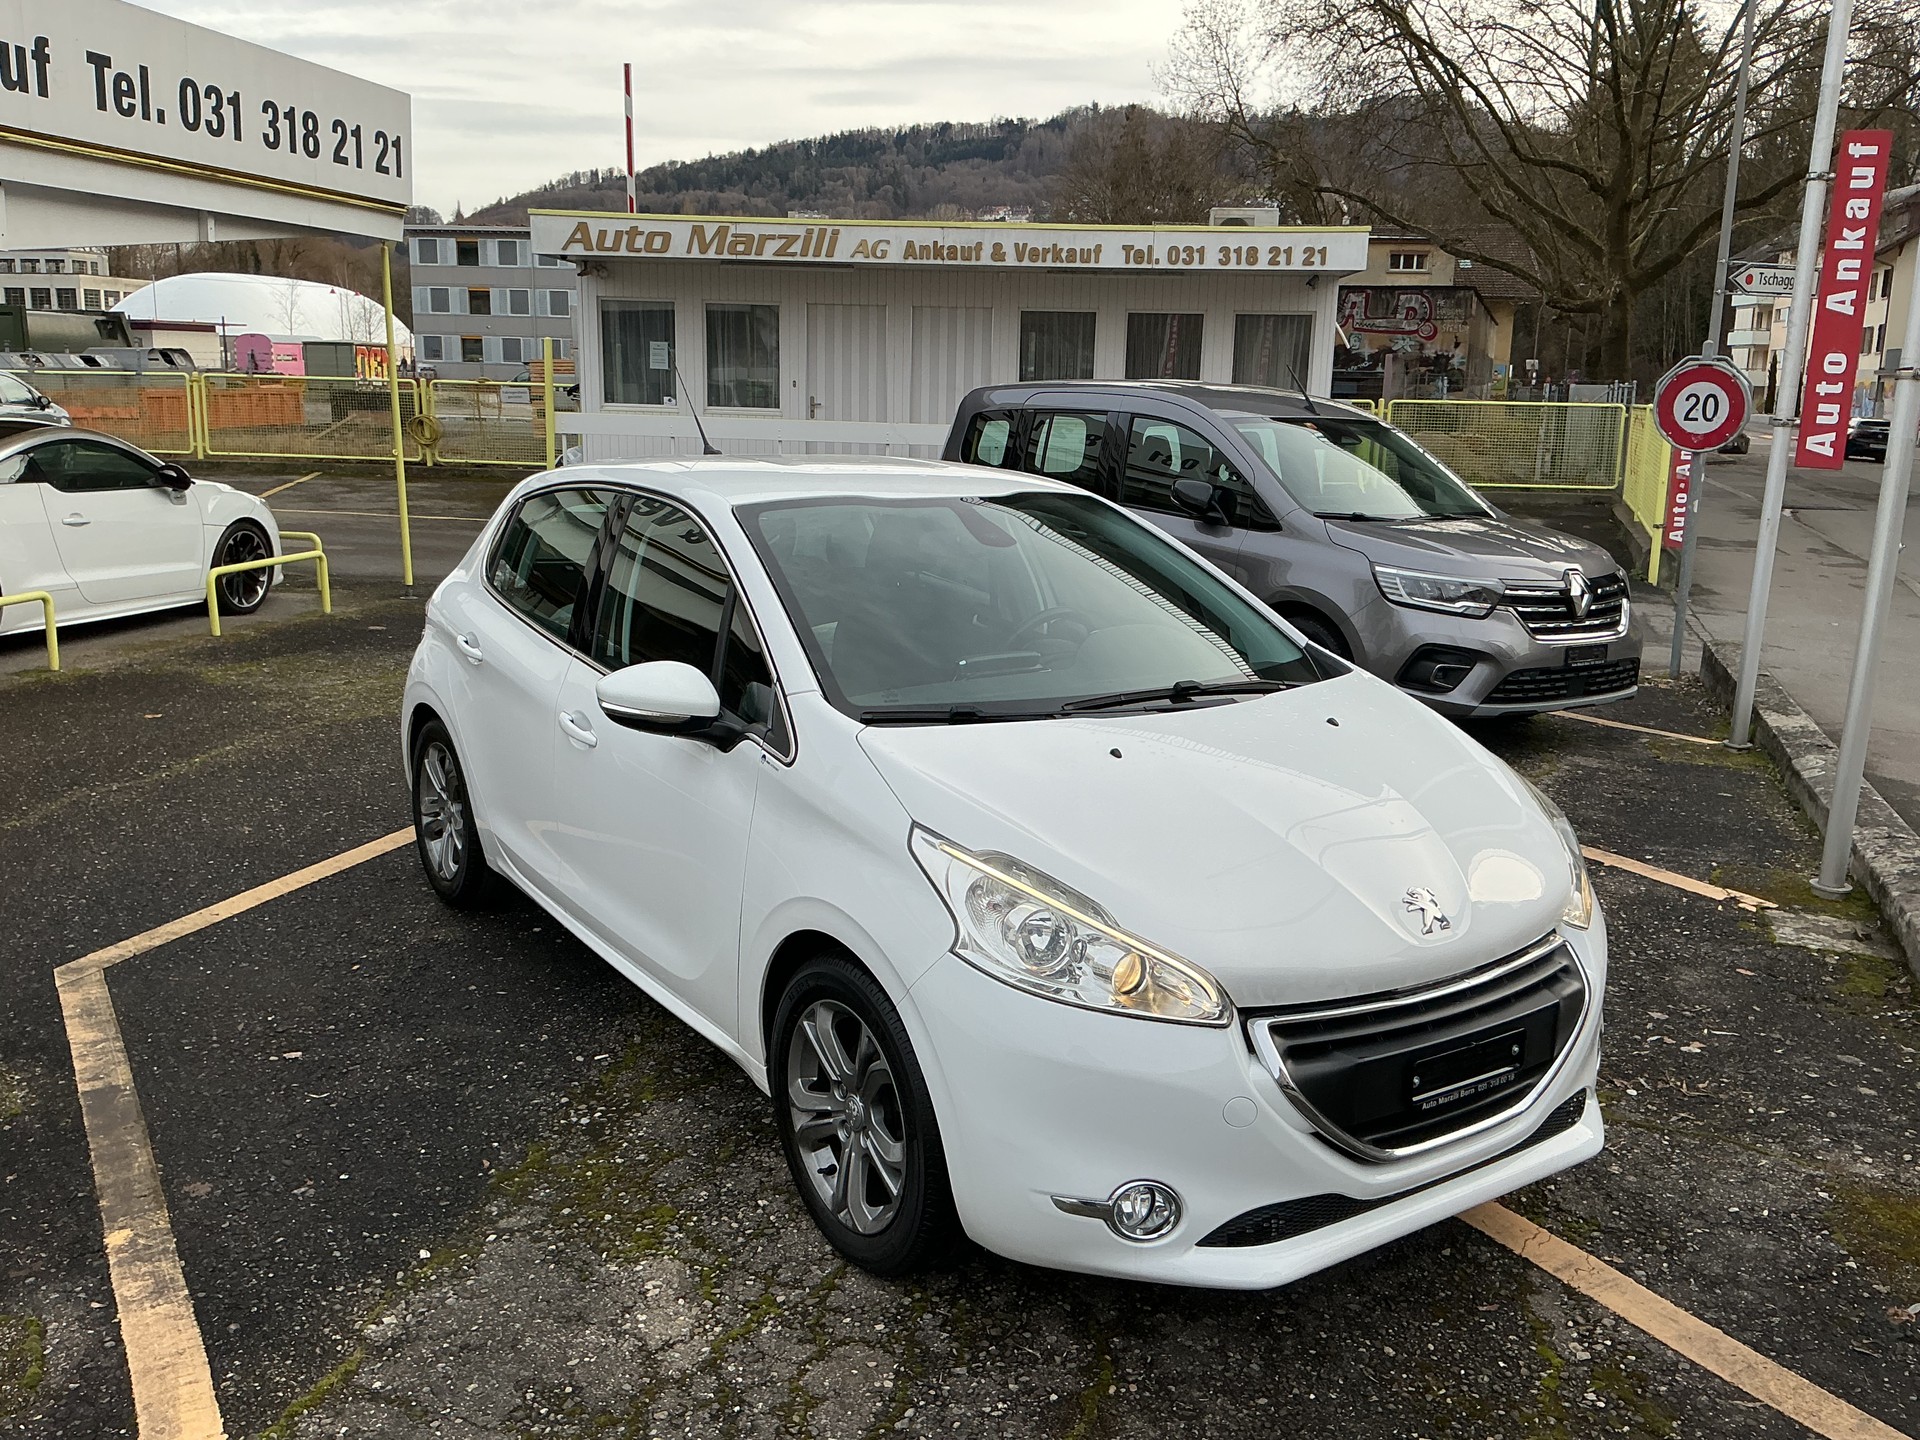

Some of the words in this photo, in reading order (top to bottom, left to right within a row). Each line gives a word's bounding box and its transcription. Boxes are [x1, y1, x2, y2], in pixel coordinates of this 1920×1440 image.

[86, 50, 166, 125] Tel.
[179, 77, 242, 142] 031
[262, 100, 320, 159] 318
[332, 119, 363, 169] 21
[374, 130, 402, 178] 21
[561, 222, 672, 253] Auto
[686, 225, 840, 257] Marzili
[850, 239, 890, 259] AG
[903, 240, 983, 261] Ankauf
[991, 243, 1006, 262] &
[1014, 242, 1102, 263] Verkauf
[1122, 245, 1159, 265] Tel.
[1167, 246, 1205, 265] 031
[1218, 246, 1259, 266] 318
[1268, 246, 1293, 266] 21
[1302, 246, 1327, 266] 21
[1826, 142, 1878, 316] Ankauf
[1759, 272, 1795, 290] Tschagg
[1683, 393, 1719, 422] 20
[1806, 353, 1847, 457] Auto
[1669, 451, 1692, 542] Auto-An
[1422, 1101, 1437, 1110] Auto
